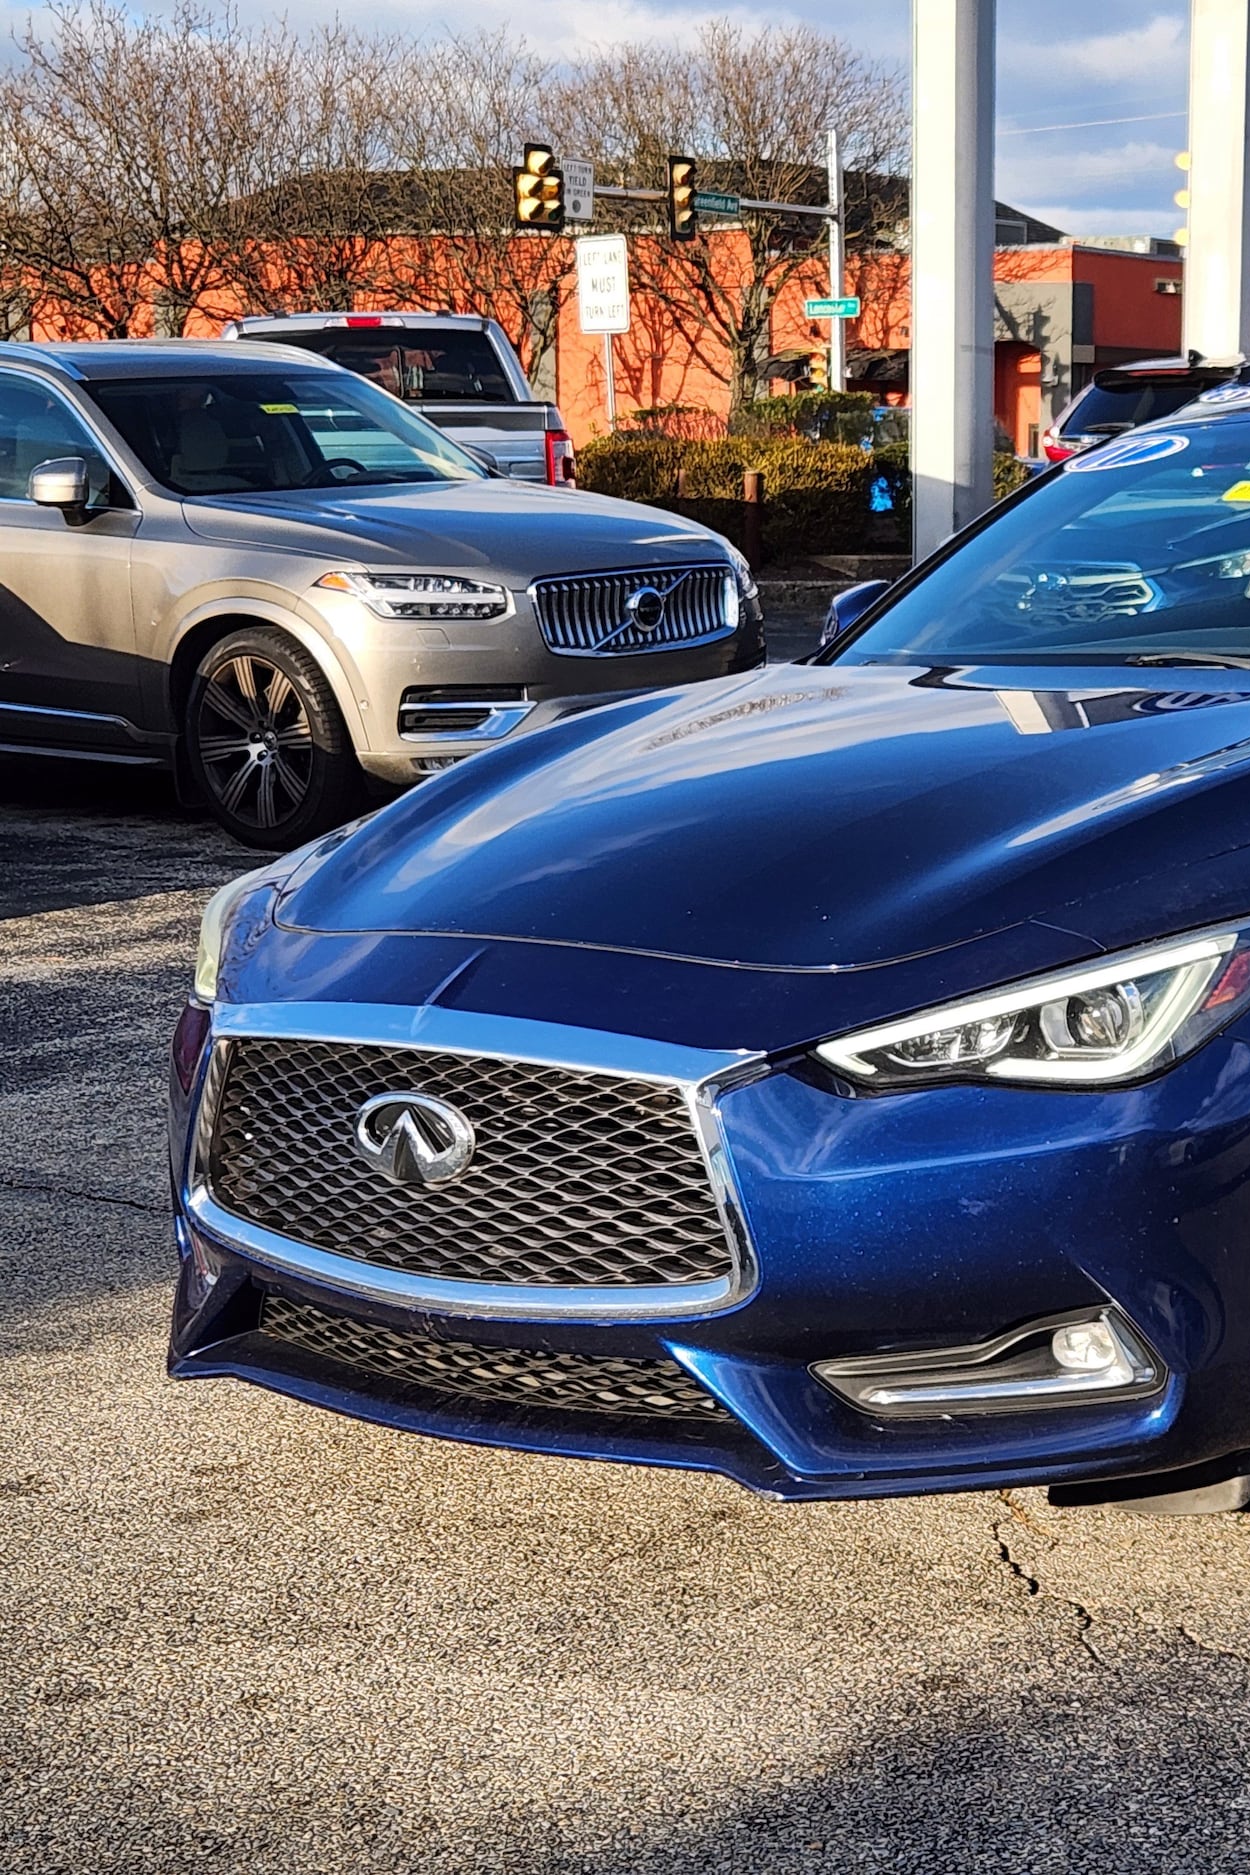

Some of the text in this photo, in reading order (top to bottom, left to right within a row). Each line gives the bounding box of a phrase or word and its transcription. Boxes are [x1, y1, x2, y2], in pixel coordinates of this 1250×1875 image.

[568, 175, 587, 187] YIELD
[583, 249, 623, 266] LEFT LANE
[591, 275, 616, 294] MUST
[585, 304, 624, 319] TURN LEFT
